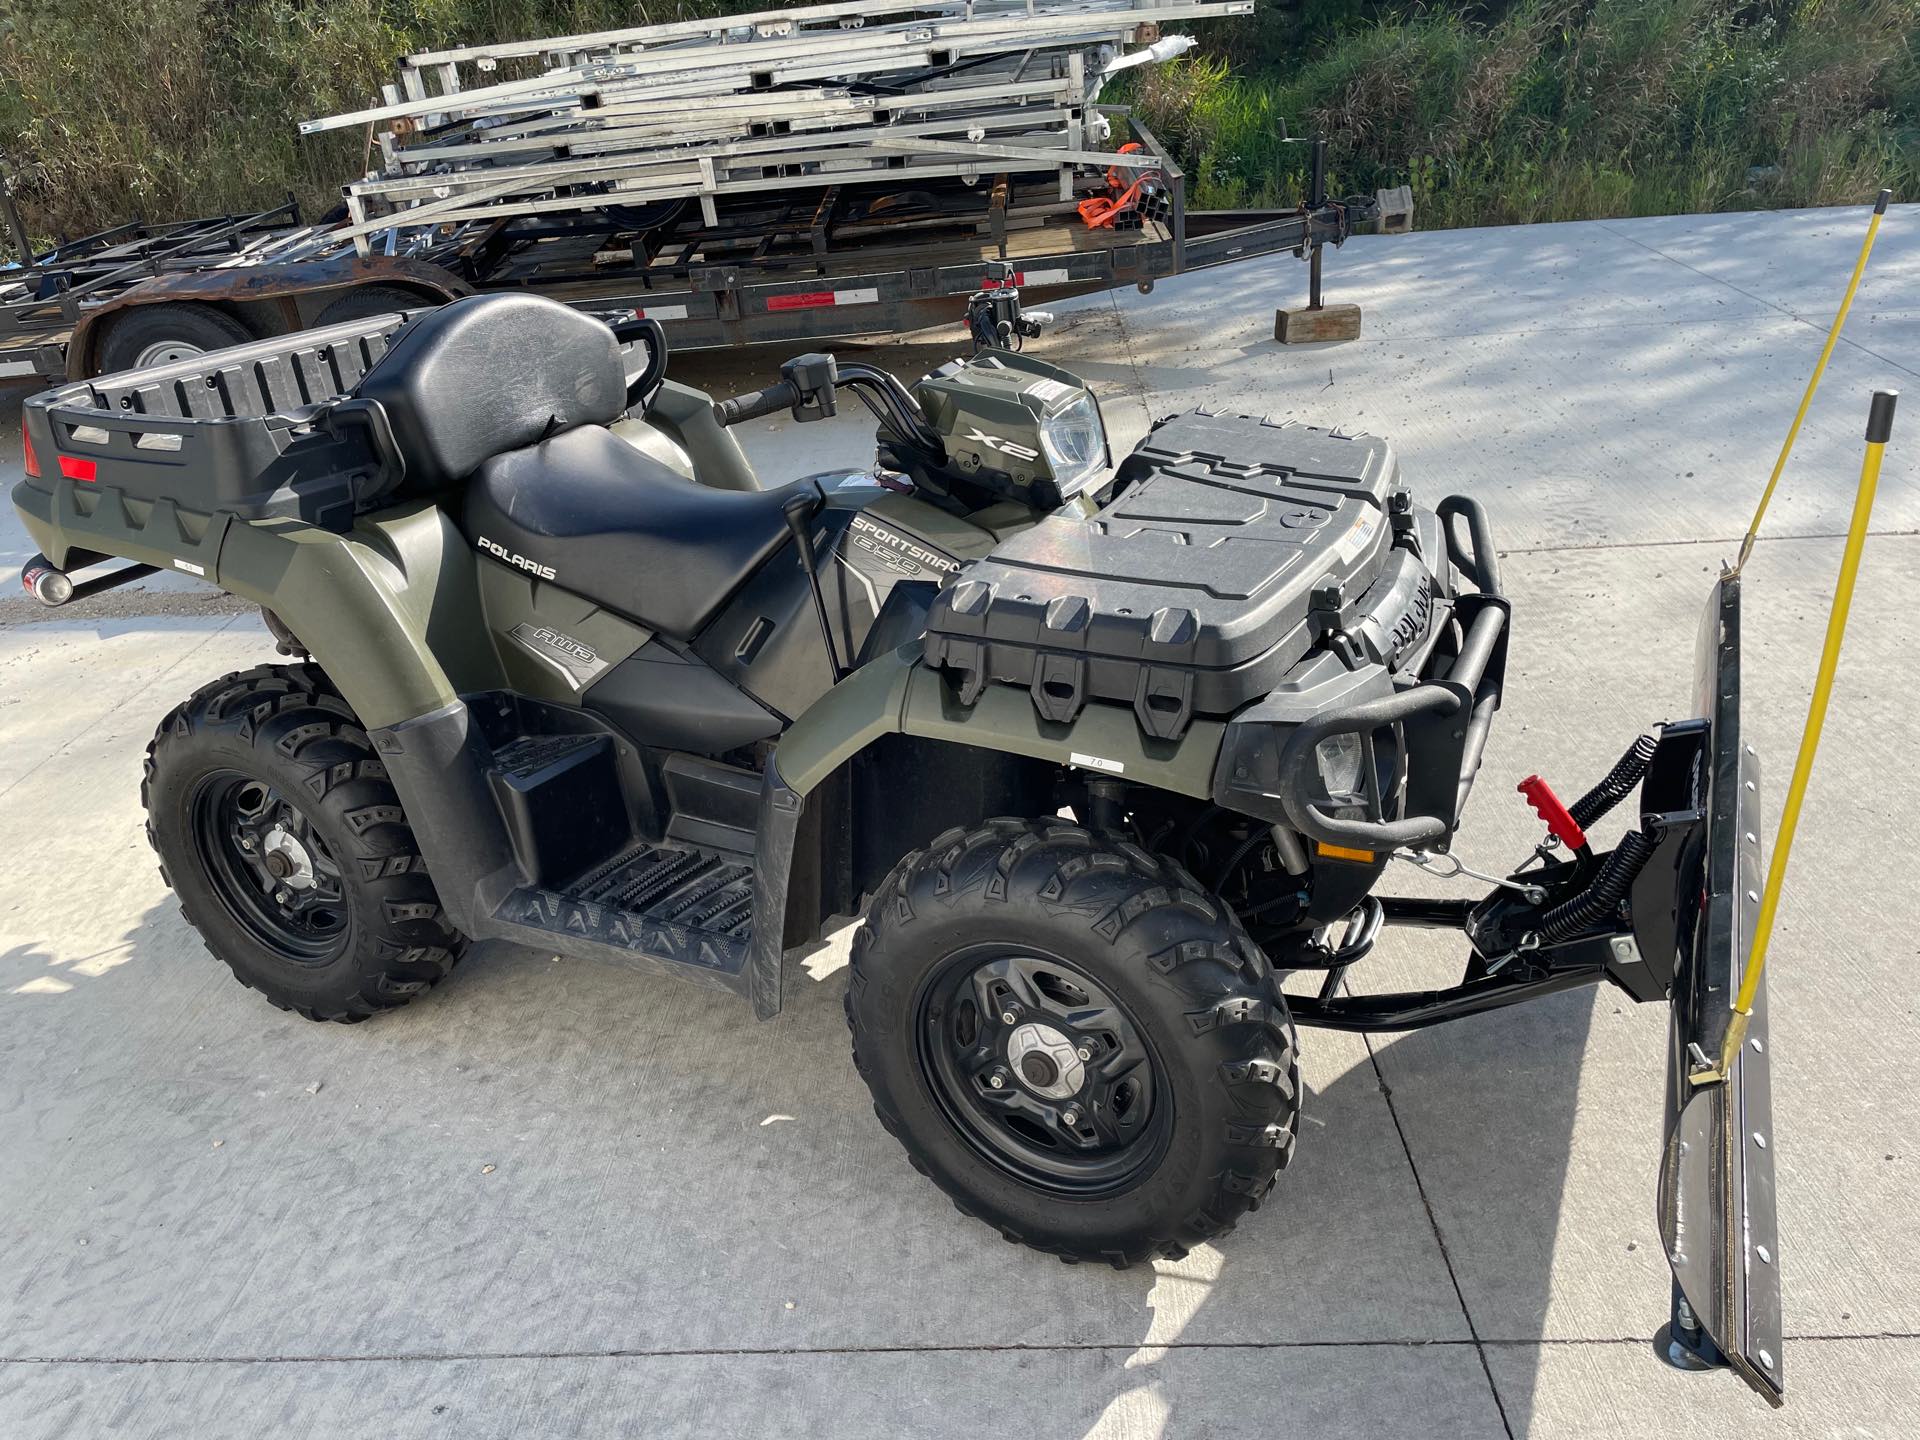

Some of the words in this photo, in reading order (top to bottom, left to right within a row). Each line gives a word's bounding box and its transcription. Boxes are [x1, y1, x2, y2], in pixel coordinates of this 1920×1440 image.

[963, 426, 1039, 462] X2
[477, 535, 557, 581] POLARIS
[533, 628, 597, 663] AWD
